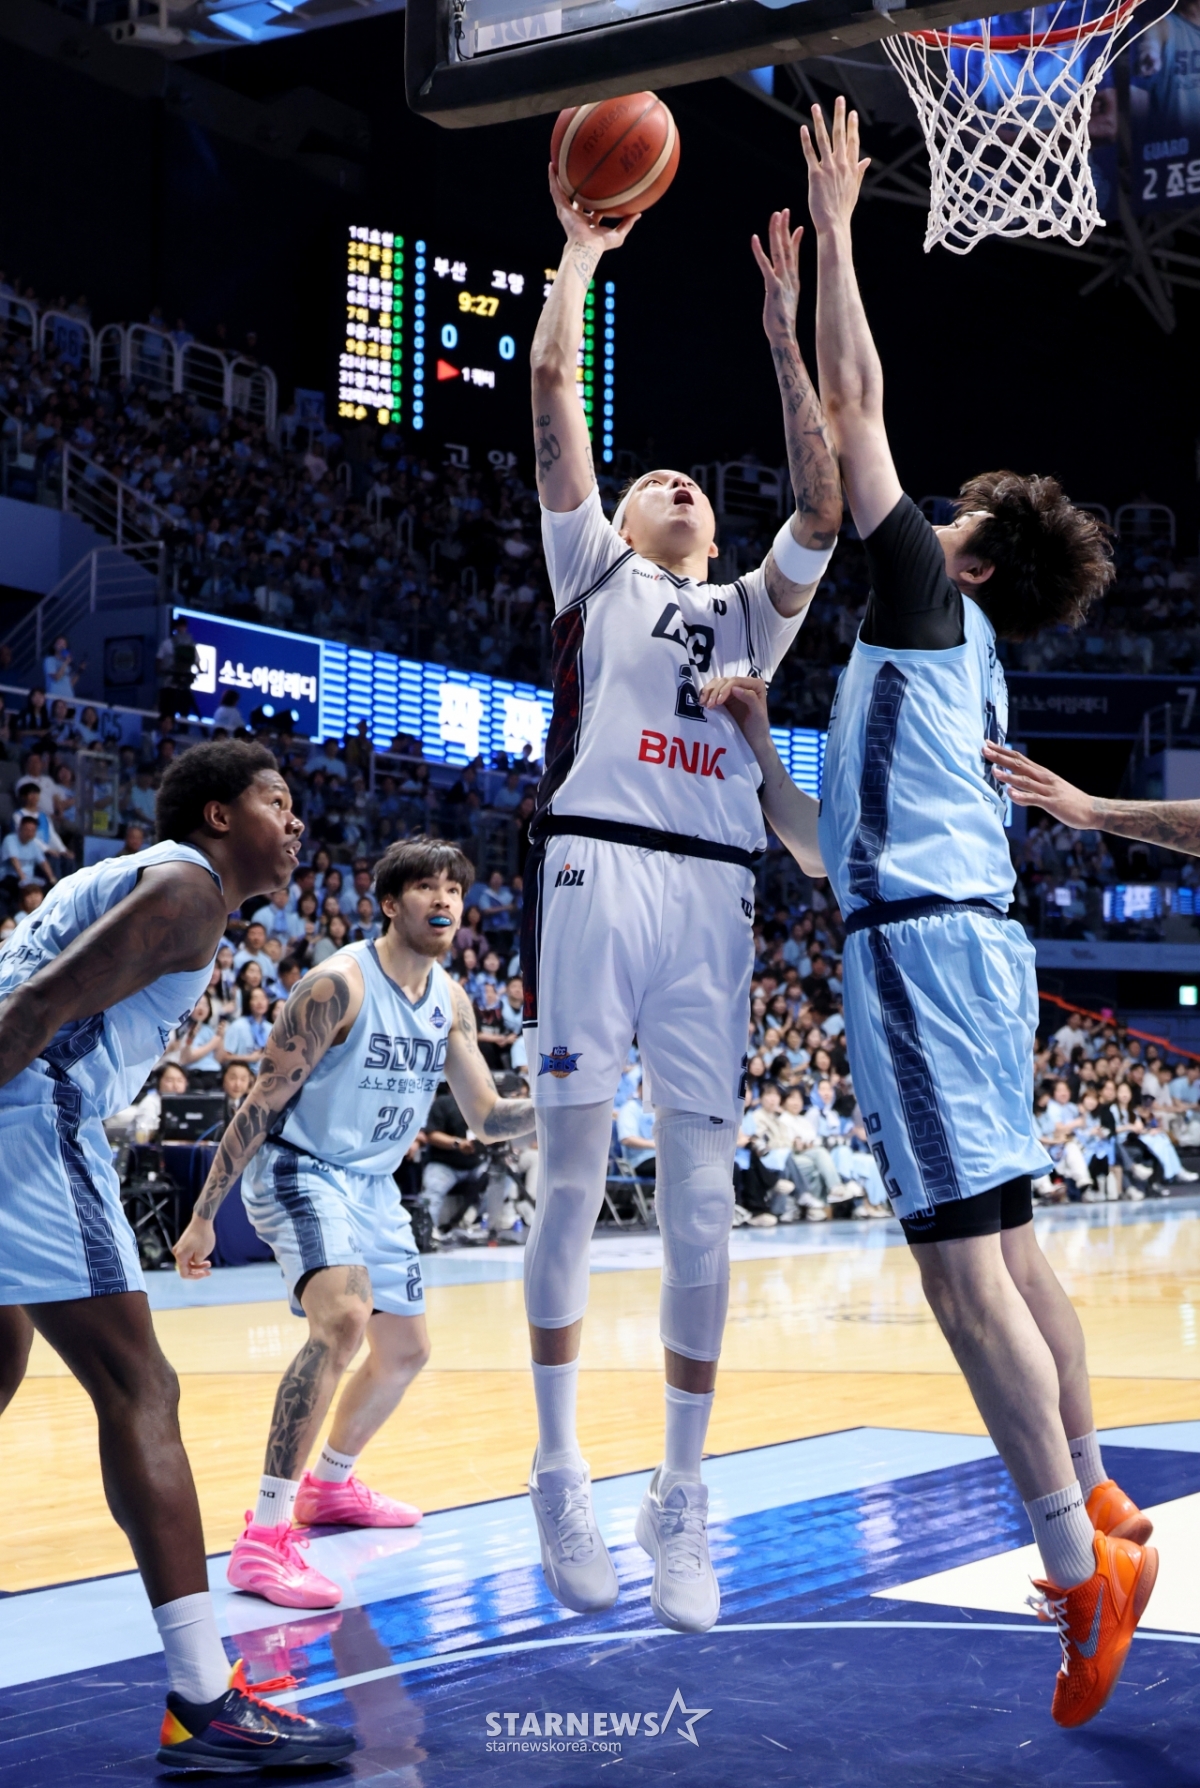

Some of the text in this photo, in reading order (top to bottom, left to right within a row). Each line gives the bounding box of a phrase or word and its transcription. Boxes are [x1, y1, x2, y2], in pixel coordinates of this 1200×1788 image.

[1142, 167, 1157, 200] 2
[433, 257, 467, 282] 부산
[491, 270, 524, 295] 고양
[459, 292, 499, 316] 9:27
[442, 324, 515, 360] 0 0
[218, 660, 317, 704] 소노아임레디
[1176, 686, 1198, 730] 7
[638, 729, 727, 781] BNK
[358, 1076, 440, 1094] 소노호텔앤리조
[371, 1106, 415, 1144] 28
